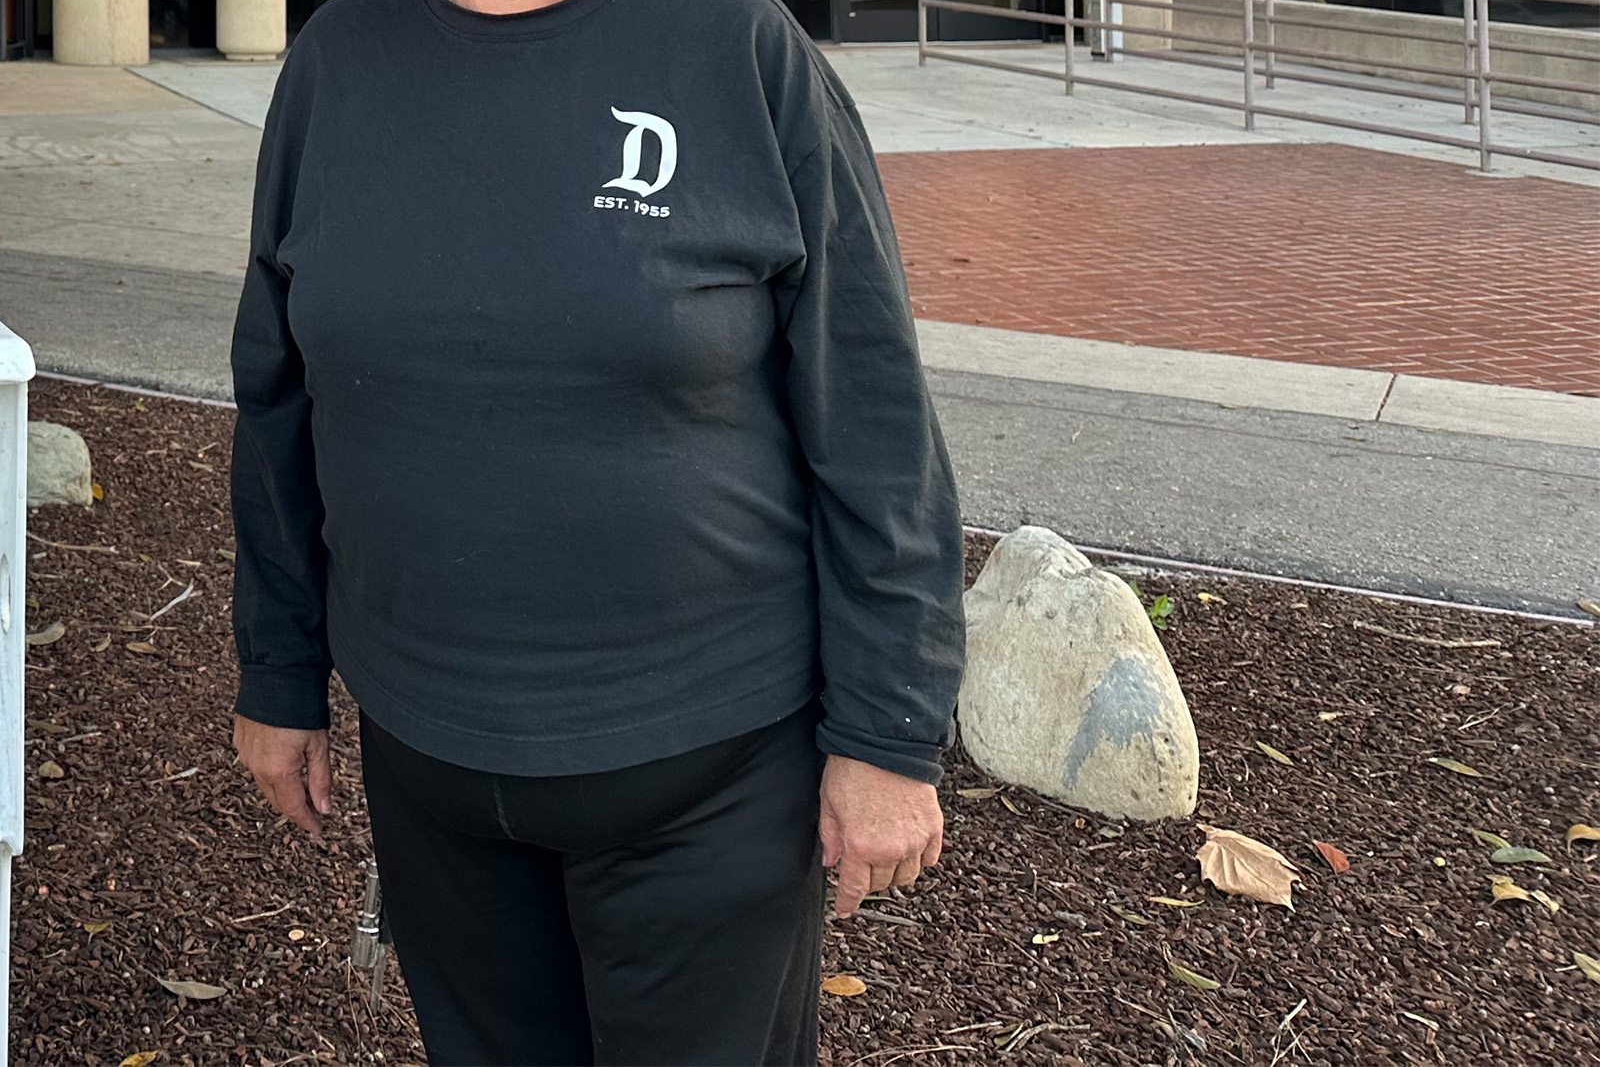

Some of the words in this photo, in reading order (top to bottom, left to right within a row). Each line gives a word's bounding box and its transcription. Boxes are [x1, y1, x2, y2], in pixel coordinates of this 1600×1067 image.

[602, 106, 677, 198] D
[593, 195, 629, 210] EST.
[634, 199, 671, 218] 1955
